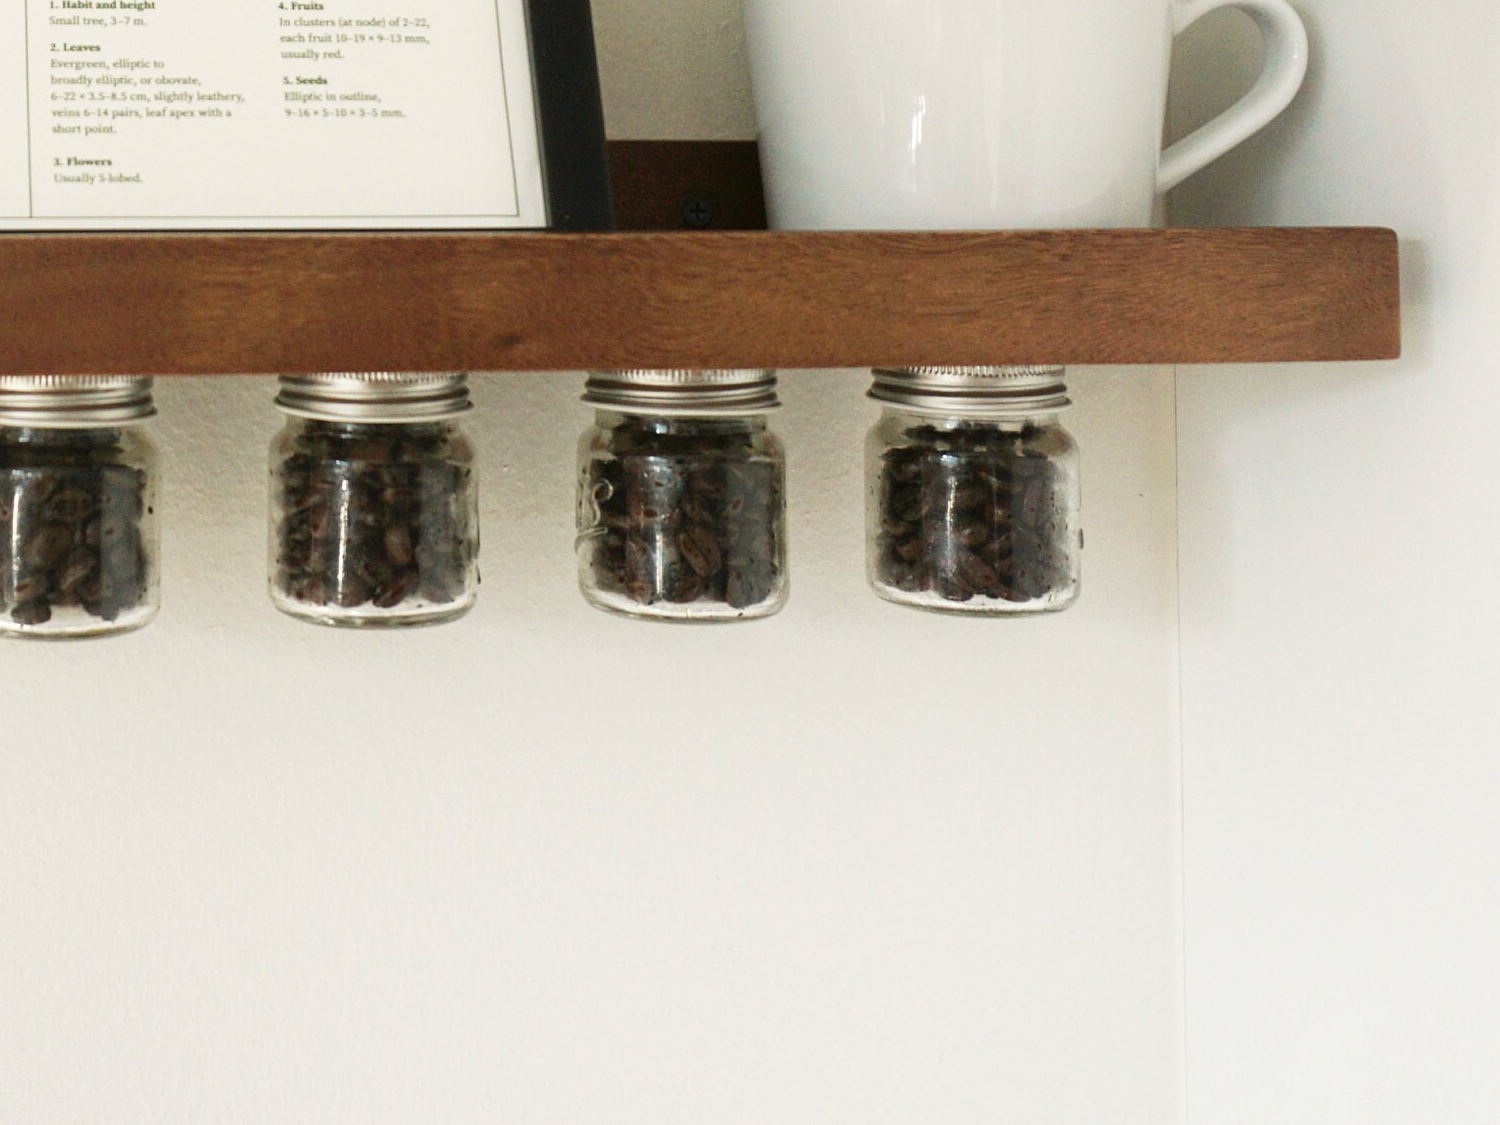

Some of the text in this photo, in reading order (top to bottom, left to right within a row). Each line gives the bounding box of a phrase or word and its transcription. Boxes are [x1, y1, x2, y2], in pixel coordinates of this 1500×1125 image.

[94, 0, 118, 10] and
[118, 0, 157, 12] height
[289, 0, 325, 12] Fruits
[48, 14, 81, 26] Small
[82, 16, 109, 28] tree,
[292, 16, 337, 28] clusters
[338, 16, 354, 29] (at
[355, 16, 387, 29] node)
[279, 32, 306, 44] each
[307, 32, 333, 44] fruit
[403, 35, 431, 46] mm,
[62, 42, 102, 53] Leaves
[280, 48, 345, 62] usually red.
[49, 58, 111, 71] Evergreen,
[111, 58, 151, 72] elliptic
[50, 74, 94, 88] broadly
[94, 74, 138, 88] elliptic,
[154, 74, 202, 87] obovate,
[294, 74, 329, 86] Seeds
[129, 93, 152, 104] cm,
[153, 90, 195, 104] slightly
[196, 90, 246, 104] leathery,
[283, 90, 323, 105] Elliptic
[338, 90, 382, 104] outline,
[51, 106, 82, 118] veins
[111, 106, 144, 121] pairs,
[145, 106, 168, 118] leaf
[168, 109, 196, 120] apex
[197, 106, 224, 118] with
[380, 109, 407, 118] mm.
[51, 123, 118, 137] short point.
[65, 155, 113, 168] Flowers
[53, 172, 97, 186] Usually
